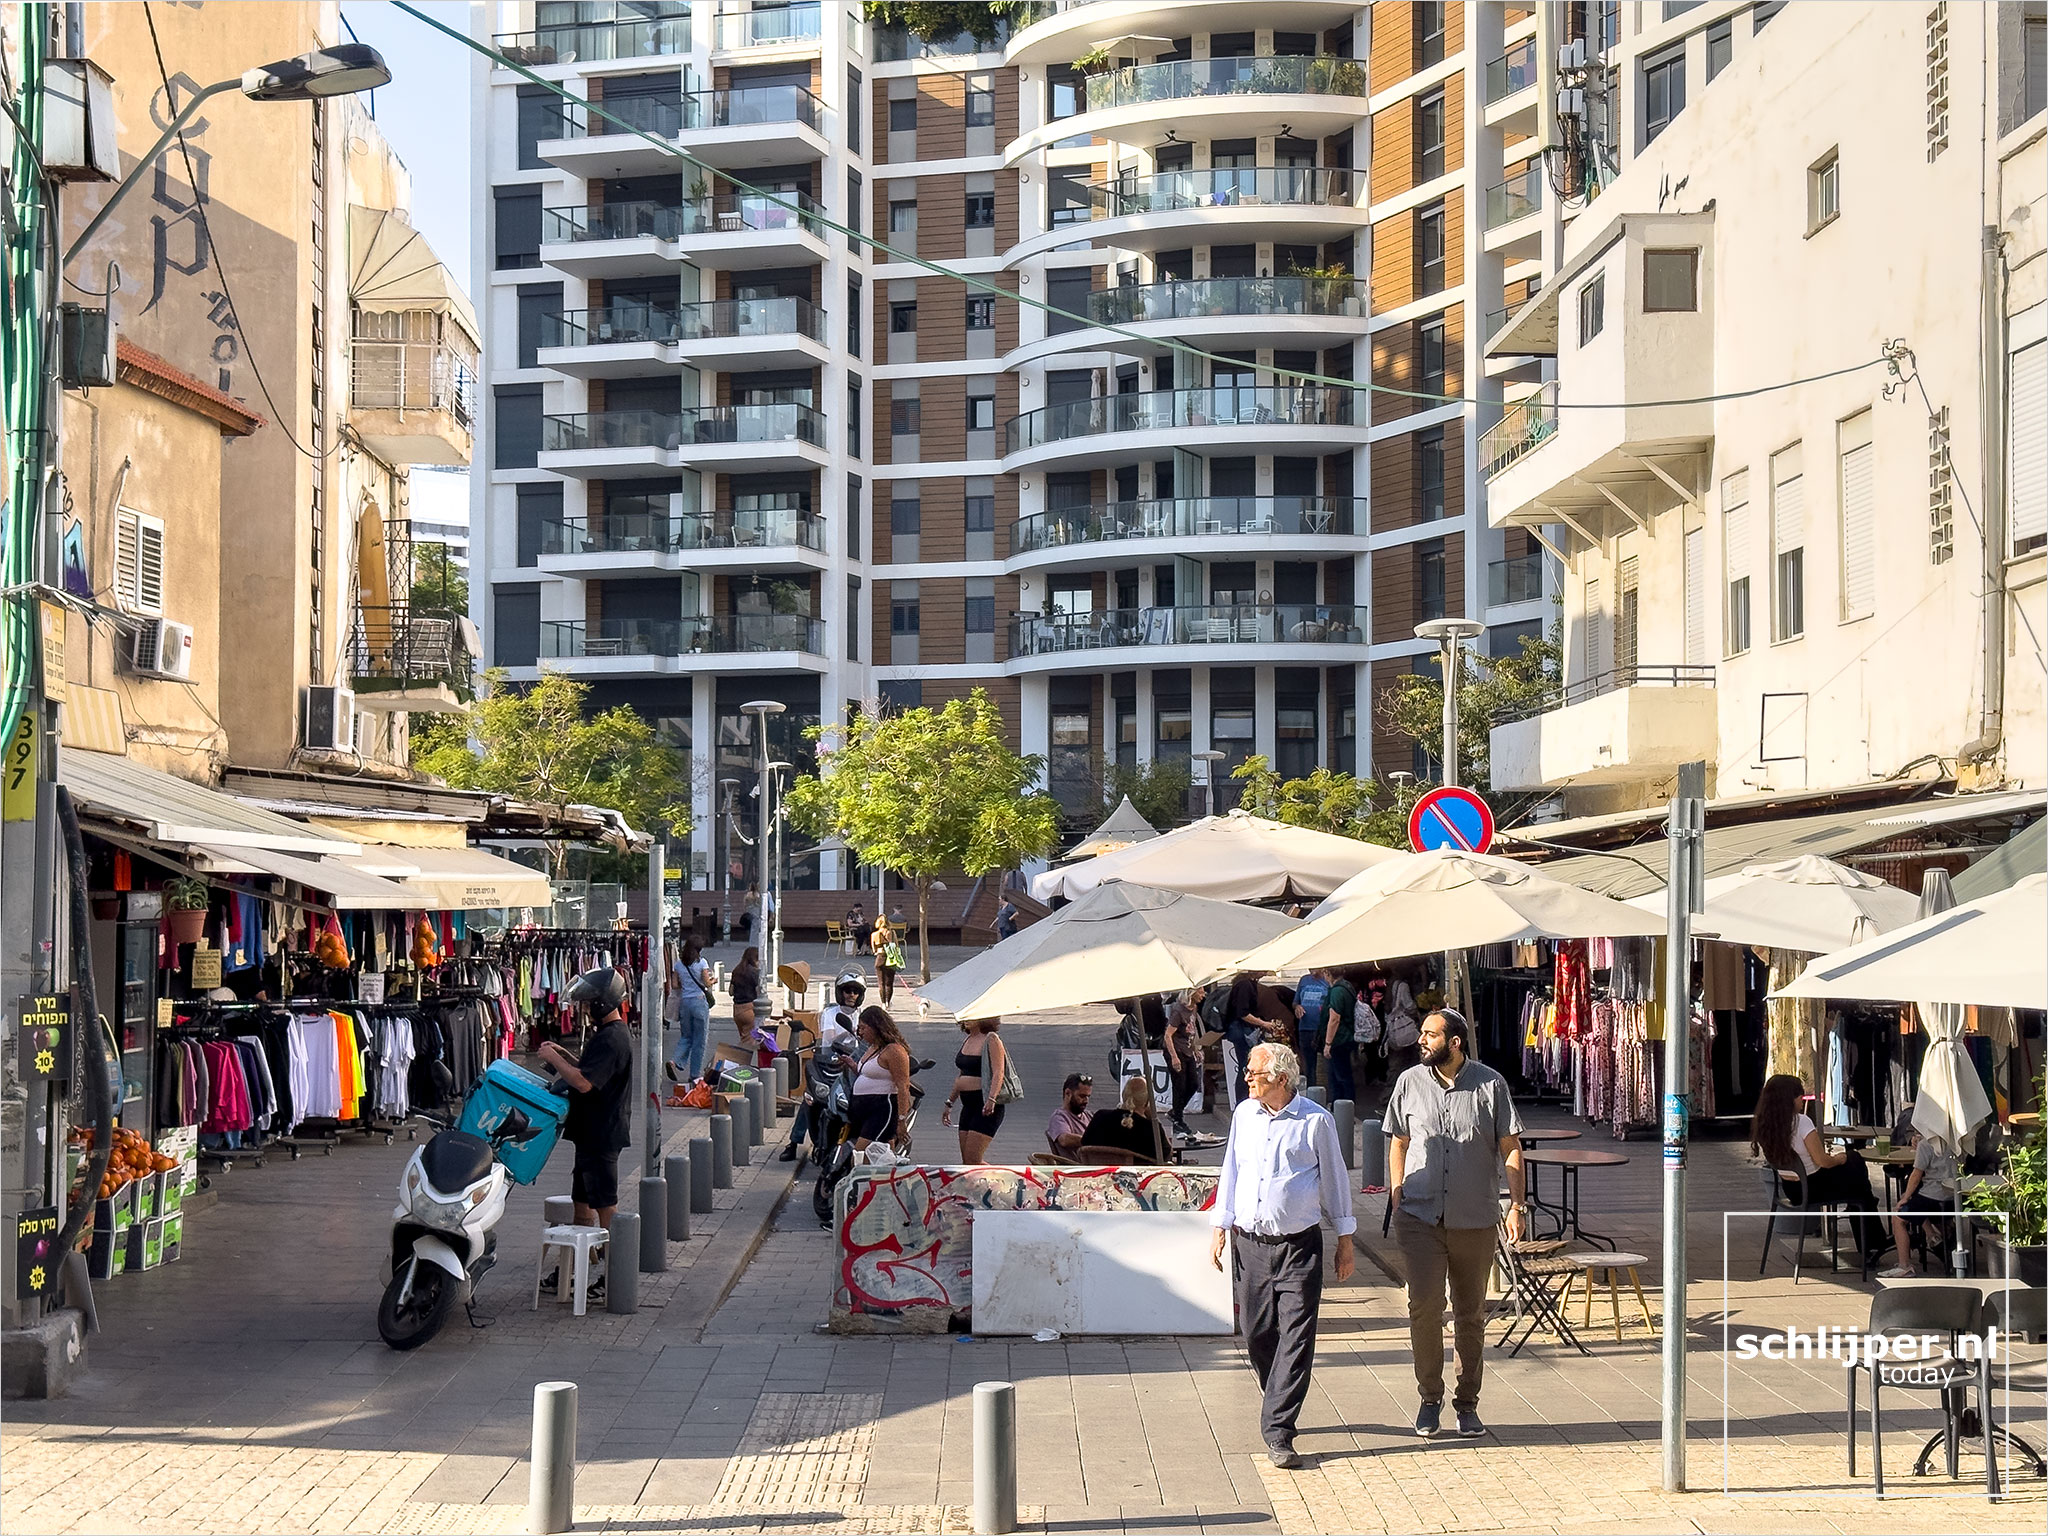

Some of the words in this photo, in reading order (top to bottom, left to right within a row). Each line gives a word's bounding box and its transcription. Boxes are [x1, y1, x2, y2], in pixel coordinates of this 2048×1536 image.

[11, 715, 34, 791] 397
[34, 997, 56, 1012] מיץ
[22, 1012, 68, 1026] תפוחים
[19, 1219, 38, 1238] סלק
[40, 1218, 56, 1234] מיץ
